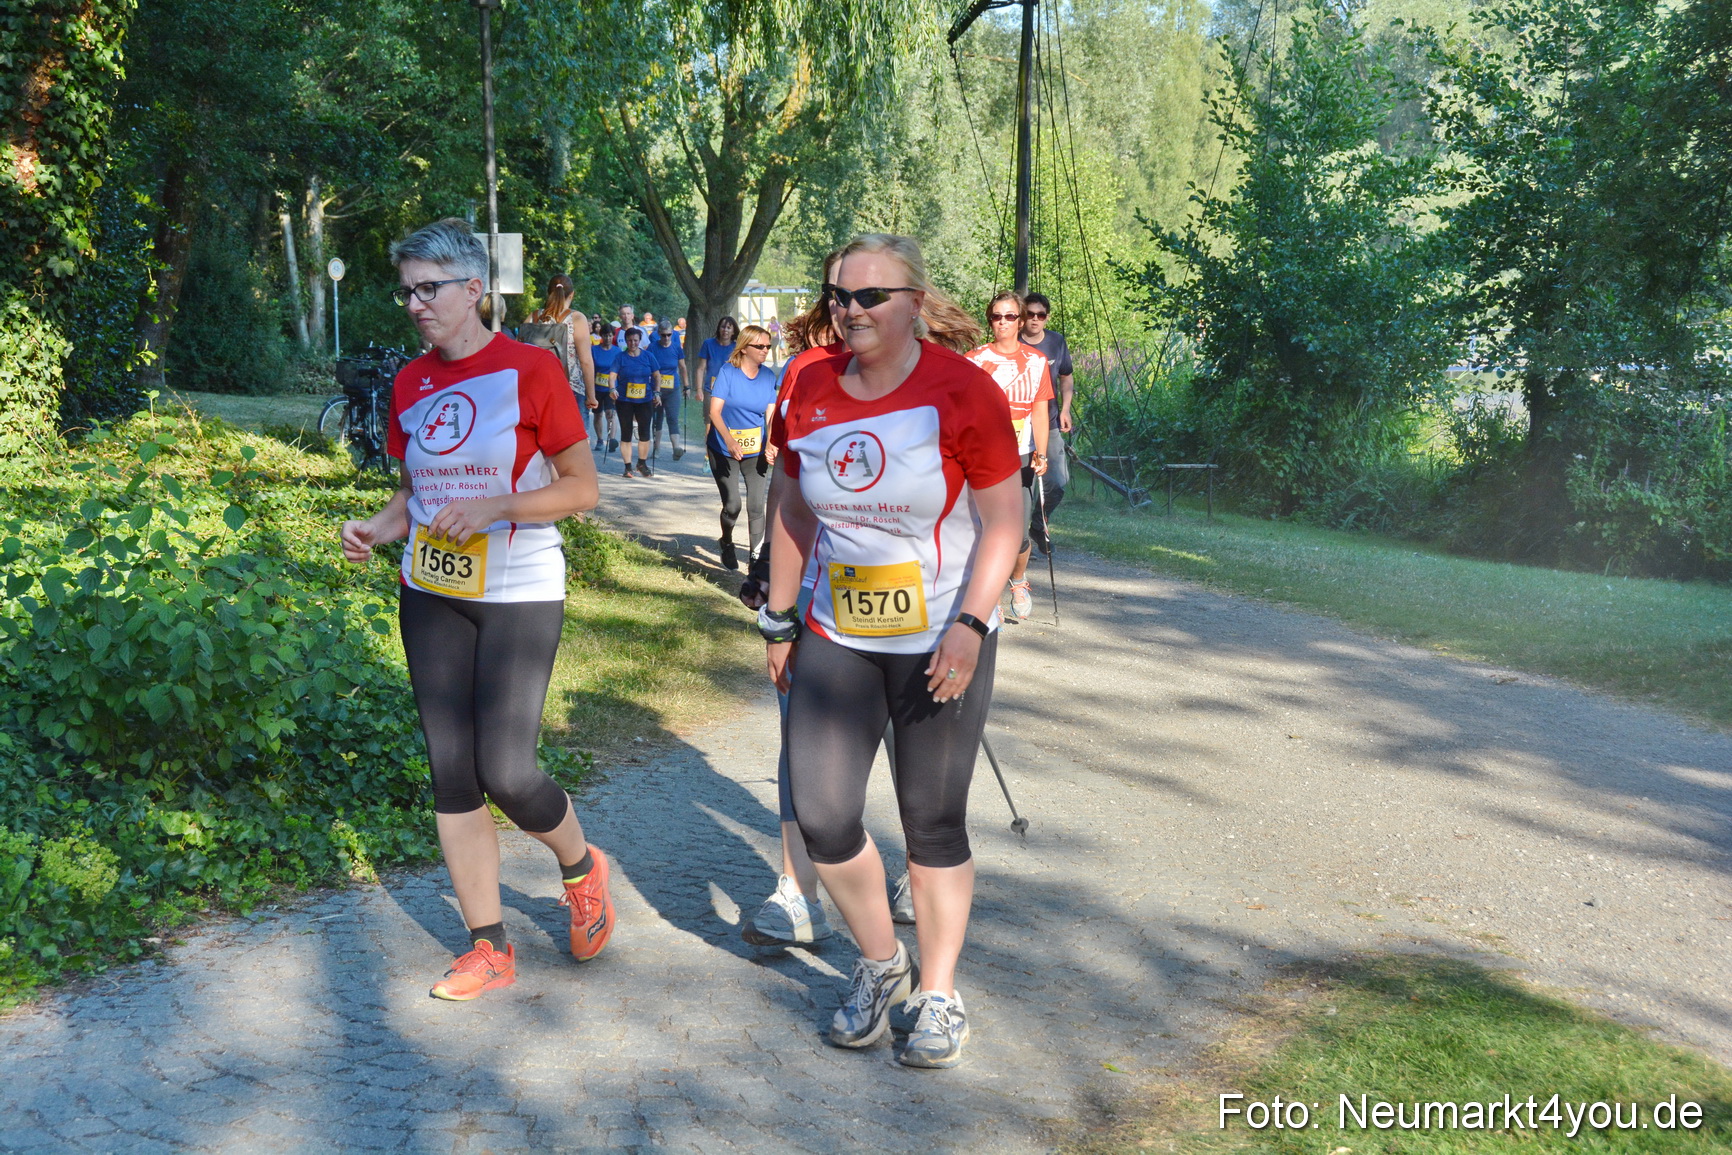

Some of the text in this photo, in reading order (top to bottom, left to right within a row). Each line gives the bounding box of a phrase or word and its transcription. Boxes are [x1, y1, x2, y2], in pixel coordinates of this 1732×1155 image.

[630, 387, 643, 395] 656
[410, 468, 435, 478] UFEN
[419, 483, 439, 492] Heck
[445, 482, 457, 490] Dr.
[458, 481, 488, 490] Röschl
[859, 515, 872, 523] Dr.
[420, 543, 473, 579] 1563
[440, 575, 466, 586] Carmen
[841, 589, 911, 616] 1570
[852, 615, 904, 624] Steindl Kerstin
